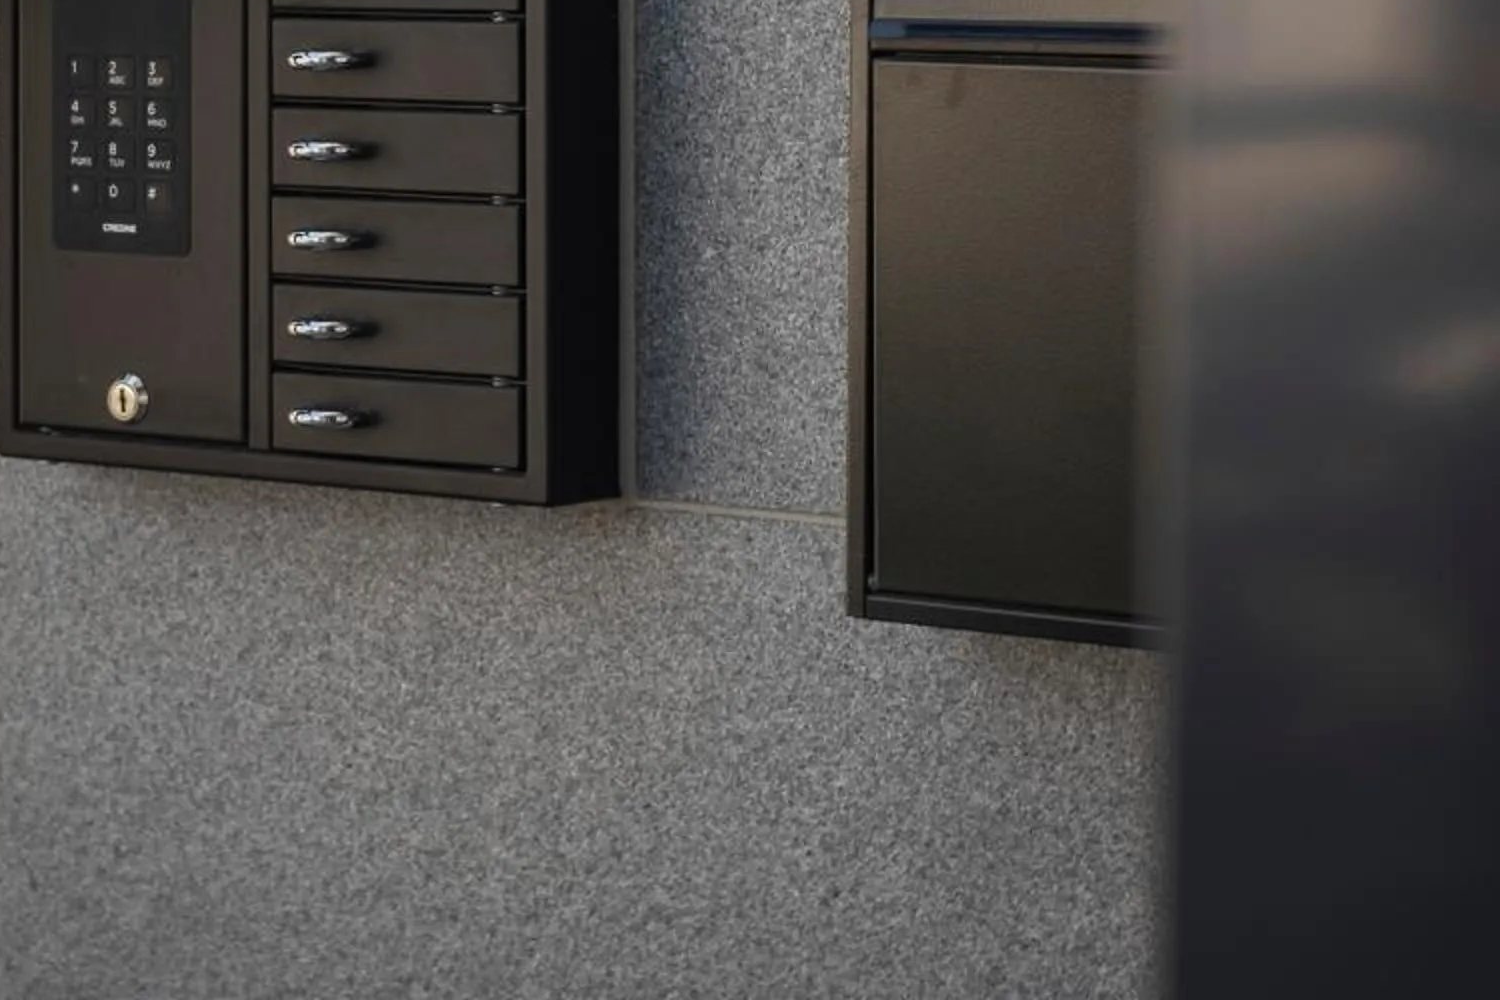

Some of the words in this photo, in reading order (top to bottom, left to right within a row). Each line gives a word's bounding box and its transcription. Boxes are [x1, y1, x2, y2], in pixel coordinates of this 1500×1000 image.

[70, 60, 77, 73] 1
[108, 61, 117, 75] 2
[147, 61, 157, 76] 3
[70, 100, 79, 113] 4
[108, 100, 117, 115] 5
[147, 101, 157, 115] 6
[70, 140, 79, 153] 7
[108, 141, 117, 156] 8
[147, 143, 157, 158] 9
[108, 183, 119, 198] 0
